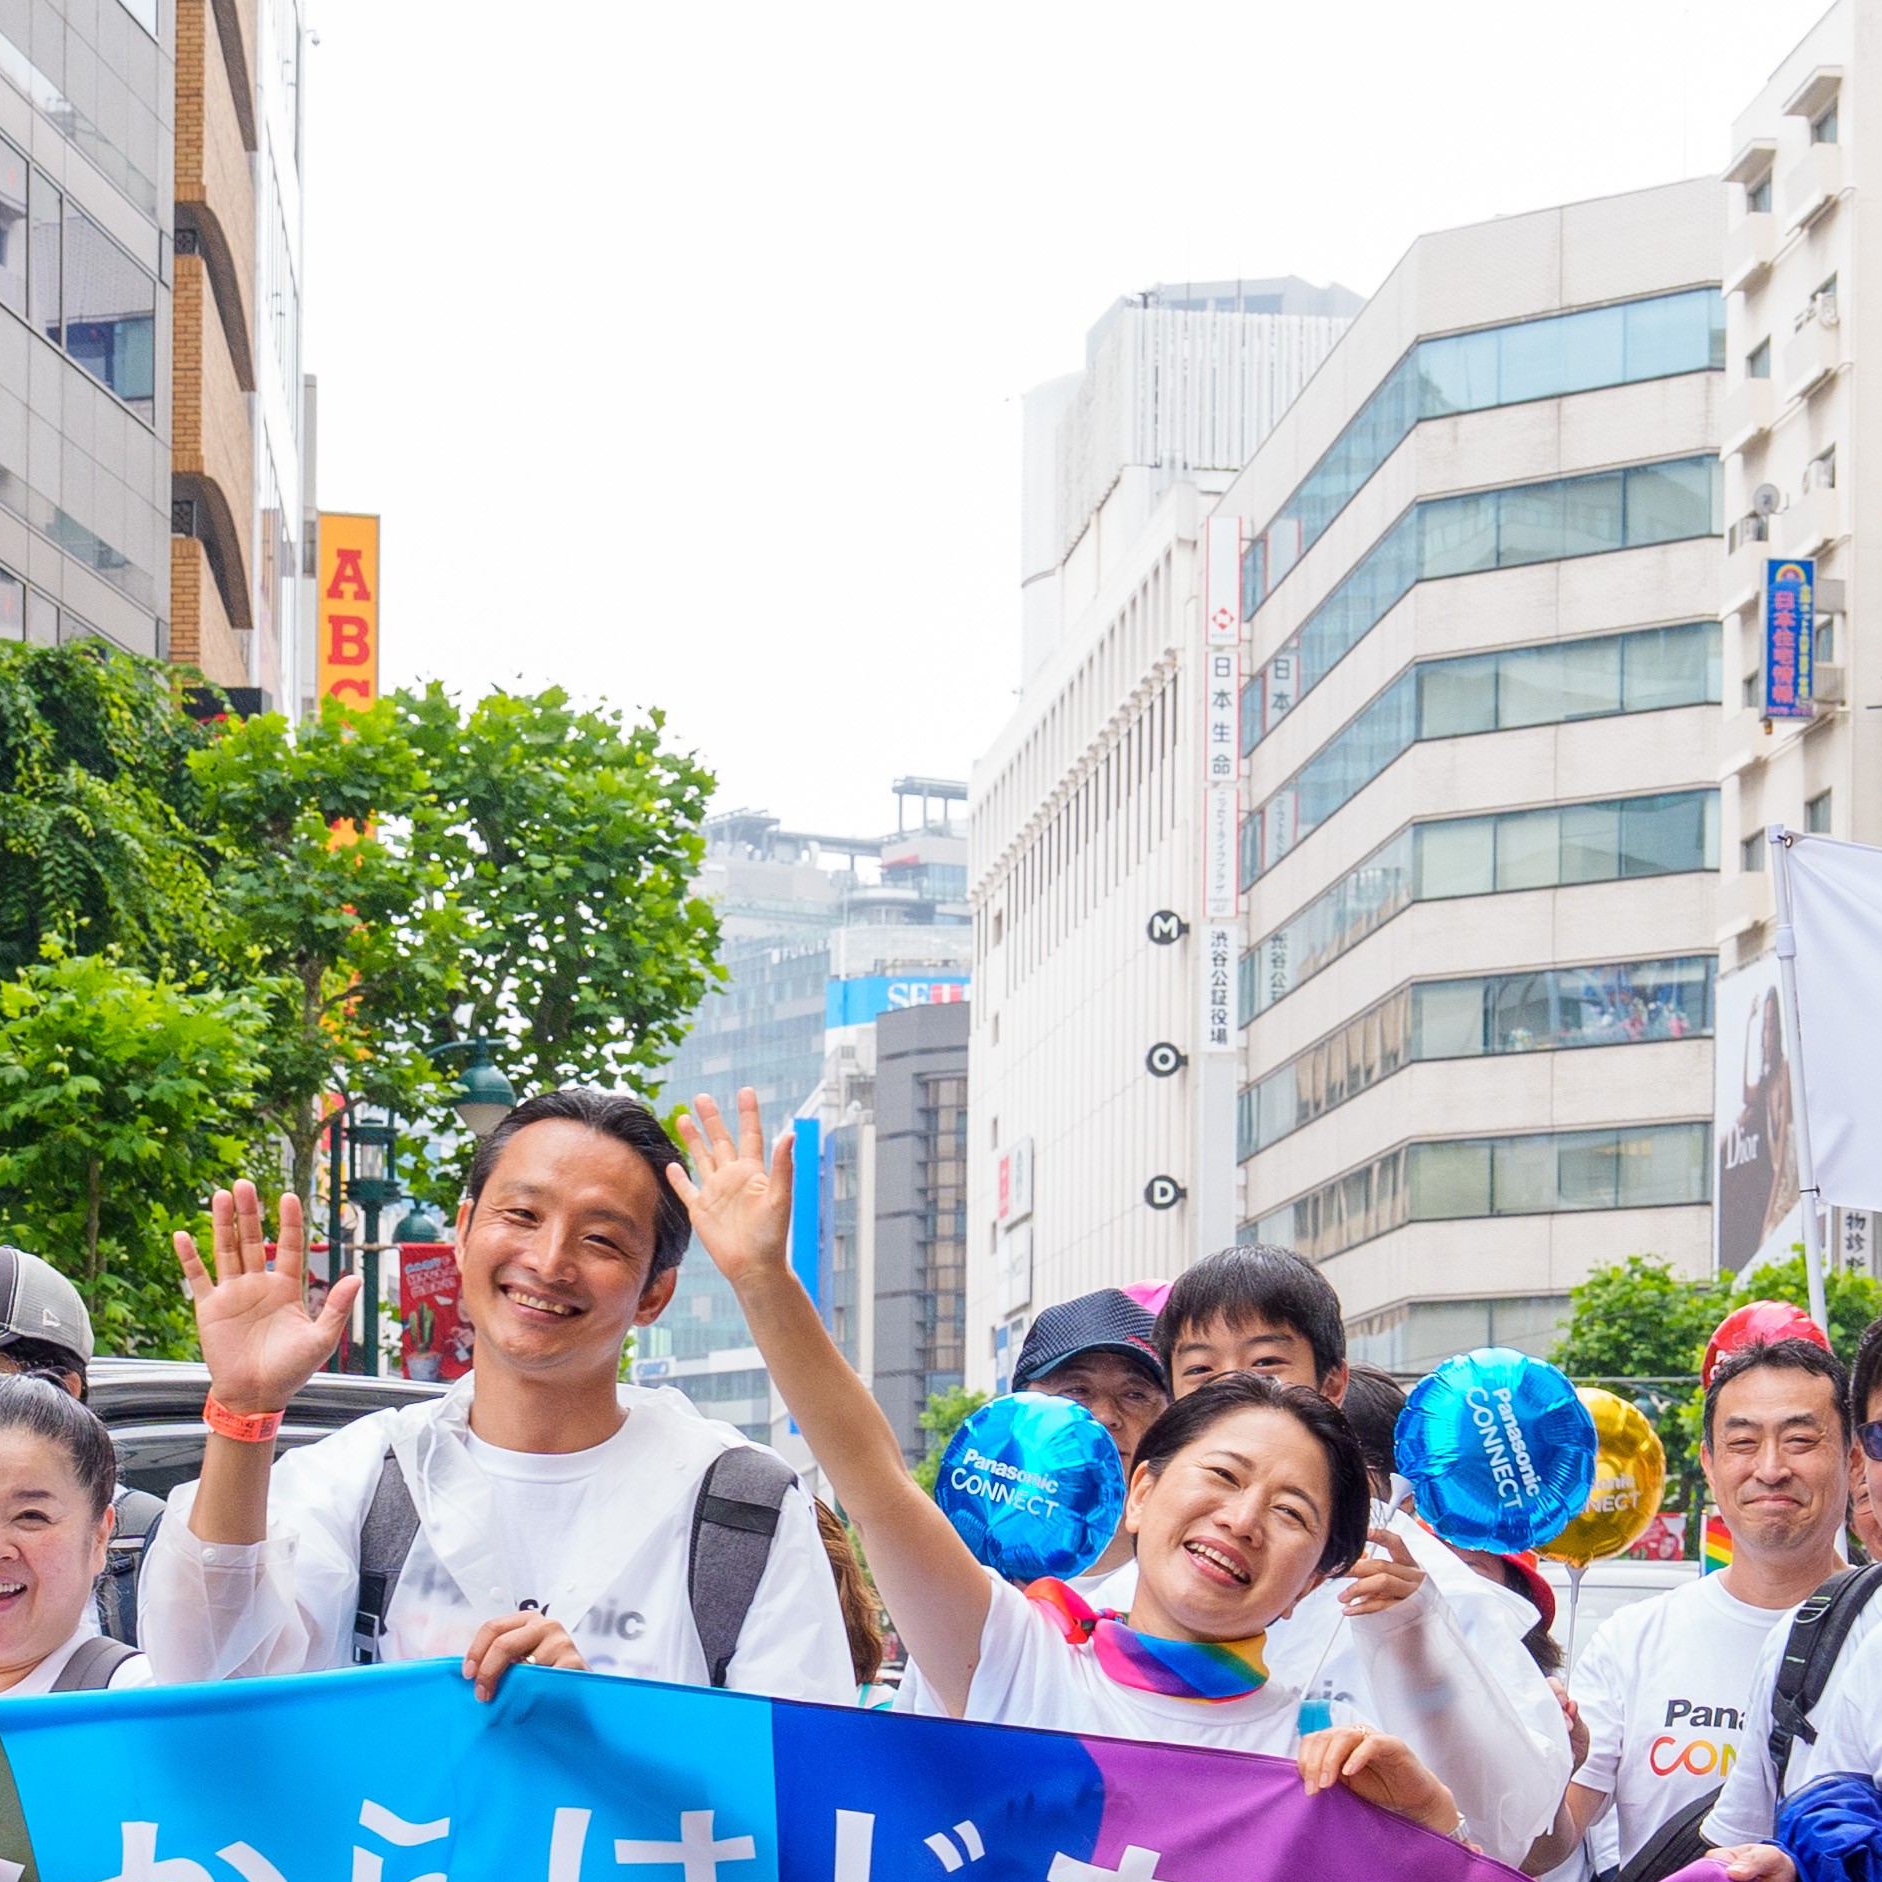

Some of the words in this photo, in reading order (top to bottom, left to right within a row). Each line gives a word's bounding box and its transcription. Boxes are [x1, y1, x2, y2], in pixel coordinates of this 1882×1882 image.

[1212, 656, 1232, 776] 日本生命
[1725, 1121, 1760, 1170] Dior
[962, 1448, 1059, 1494] Panasonic
[1464, 1386, 1525, 1510] CONNECT
[1490, 1387, 1541, 1498] Panasonic
[950, 1467, 1060, 1519] CONNECT
